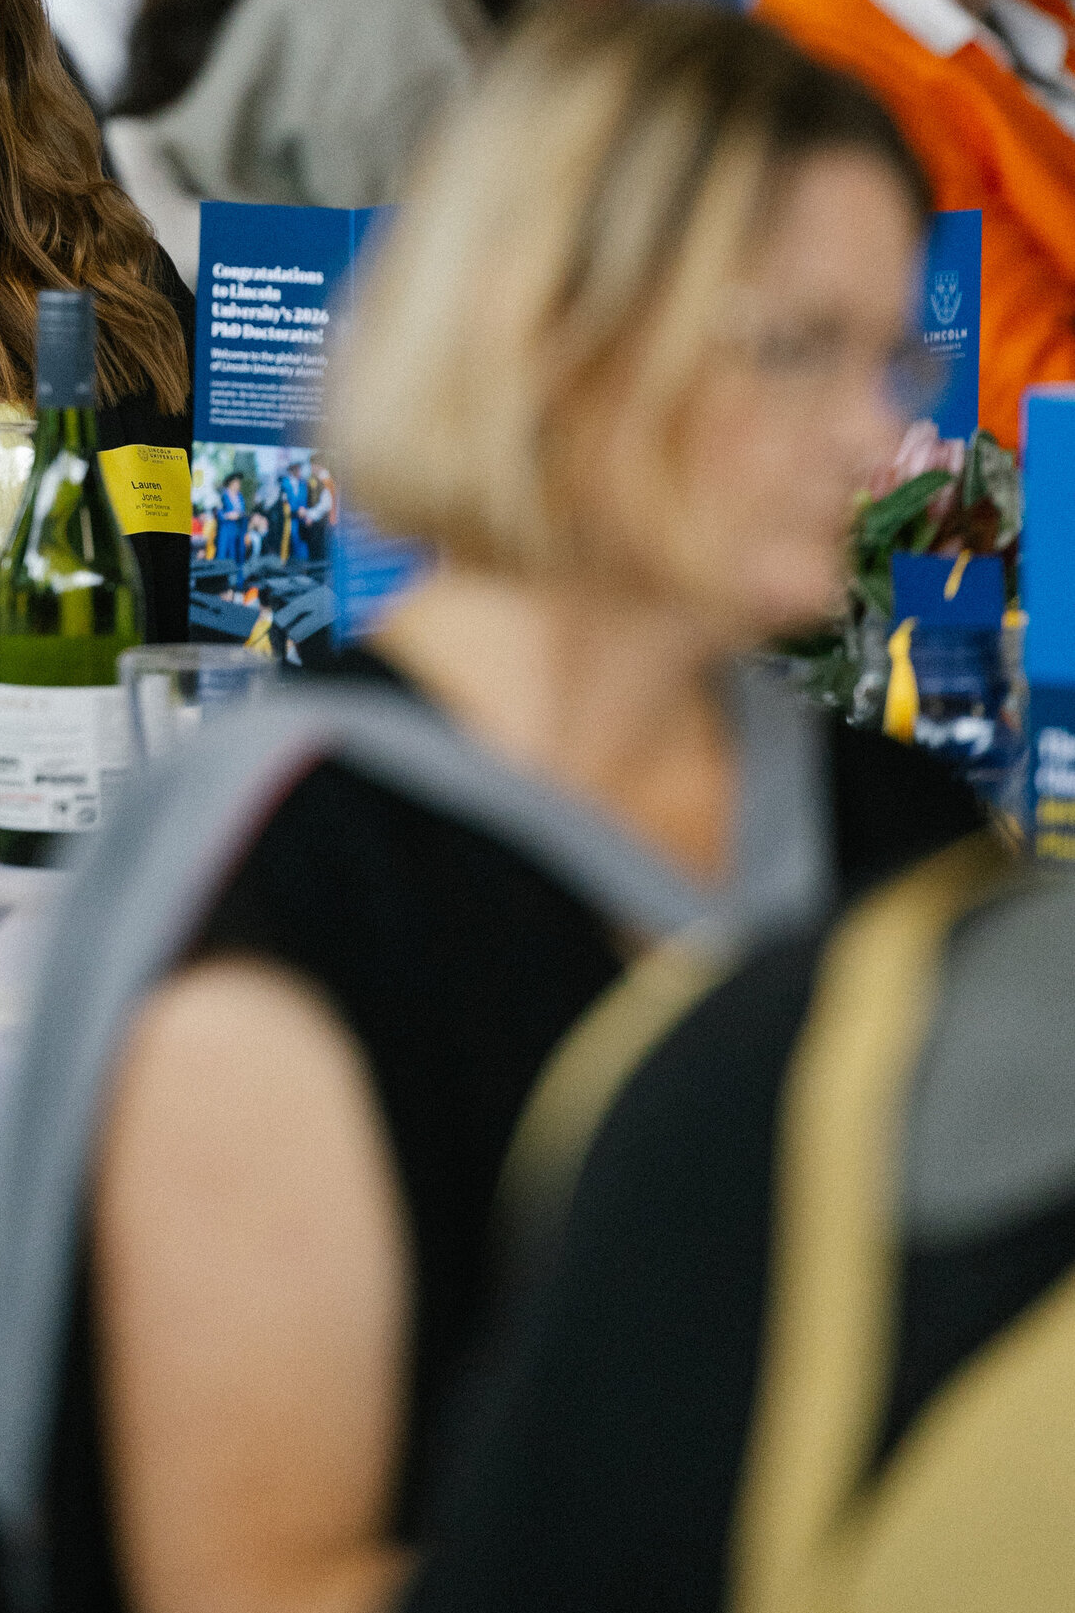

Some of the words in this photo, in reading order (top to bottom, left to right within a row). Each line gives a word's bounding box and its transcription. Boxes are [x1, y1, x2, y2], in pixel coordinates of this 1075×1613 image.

[212, 262, 324, 285] Congratulations
[212, 283, 229, 298] to
[229, 283, 282, 302] Lincoln
[211, 321, 242, 339] PhD
[242, 323, 325, 344] Doctorates!
[924, 328, 967, 343] LINCOLN
[131, 481, 162, 490] Lauren
[142, 493, 162, 501] Jones
